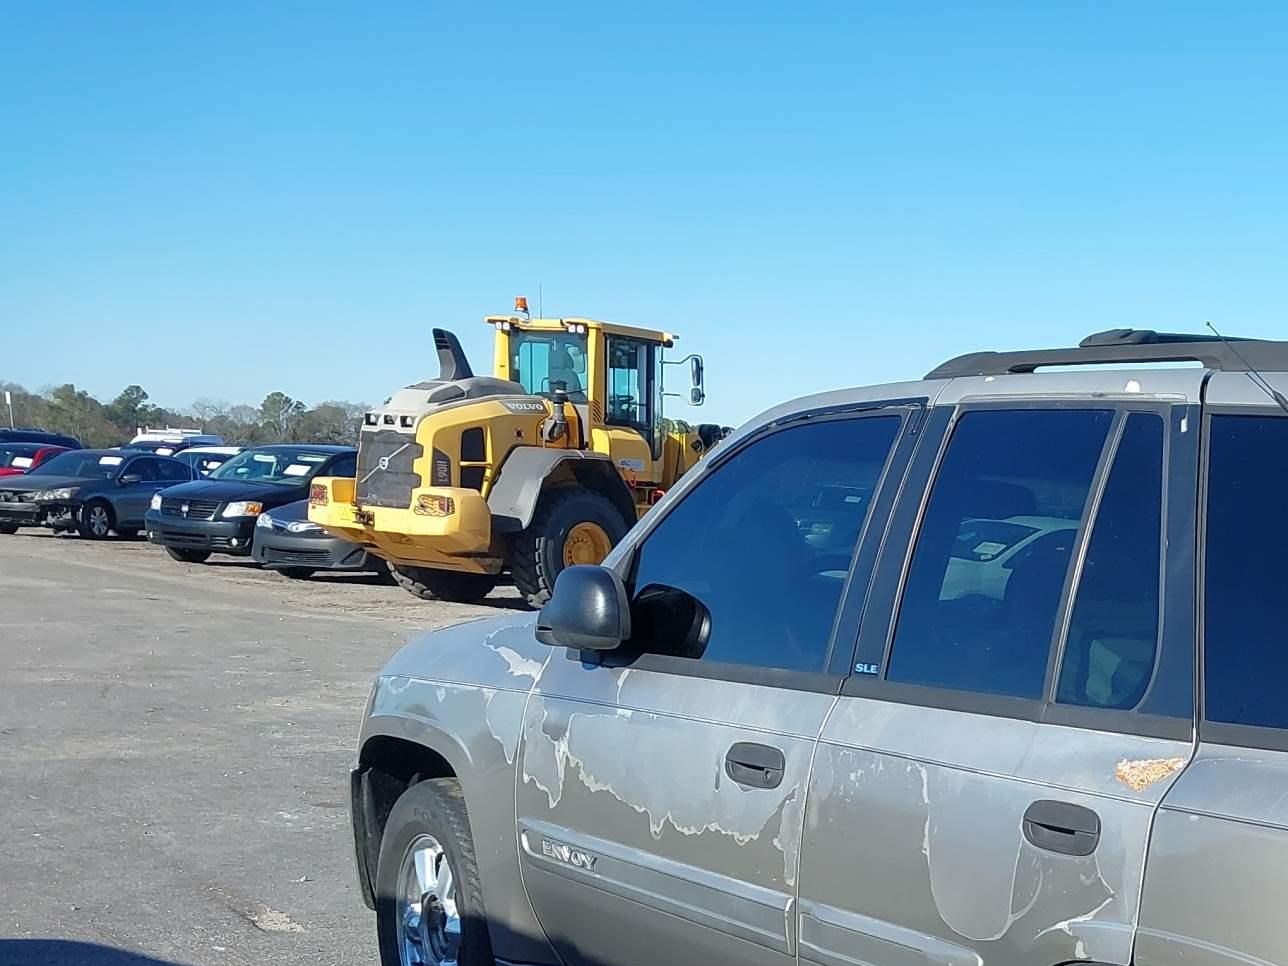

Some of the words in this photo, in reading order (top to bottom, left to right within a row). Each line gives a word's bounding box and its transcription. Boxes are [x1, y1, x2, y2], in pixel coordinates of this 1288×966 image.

[507, 402, 544, 411] VOLVO
[854, 662, 879, 674] SLE
[542, 839, 599, 872] ENVOY
